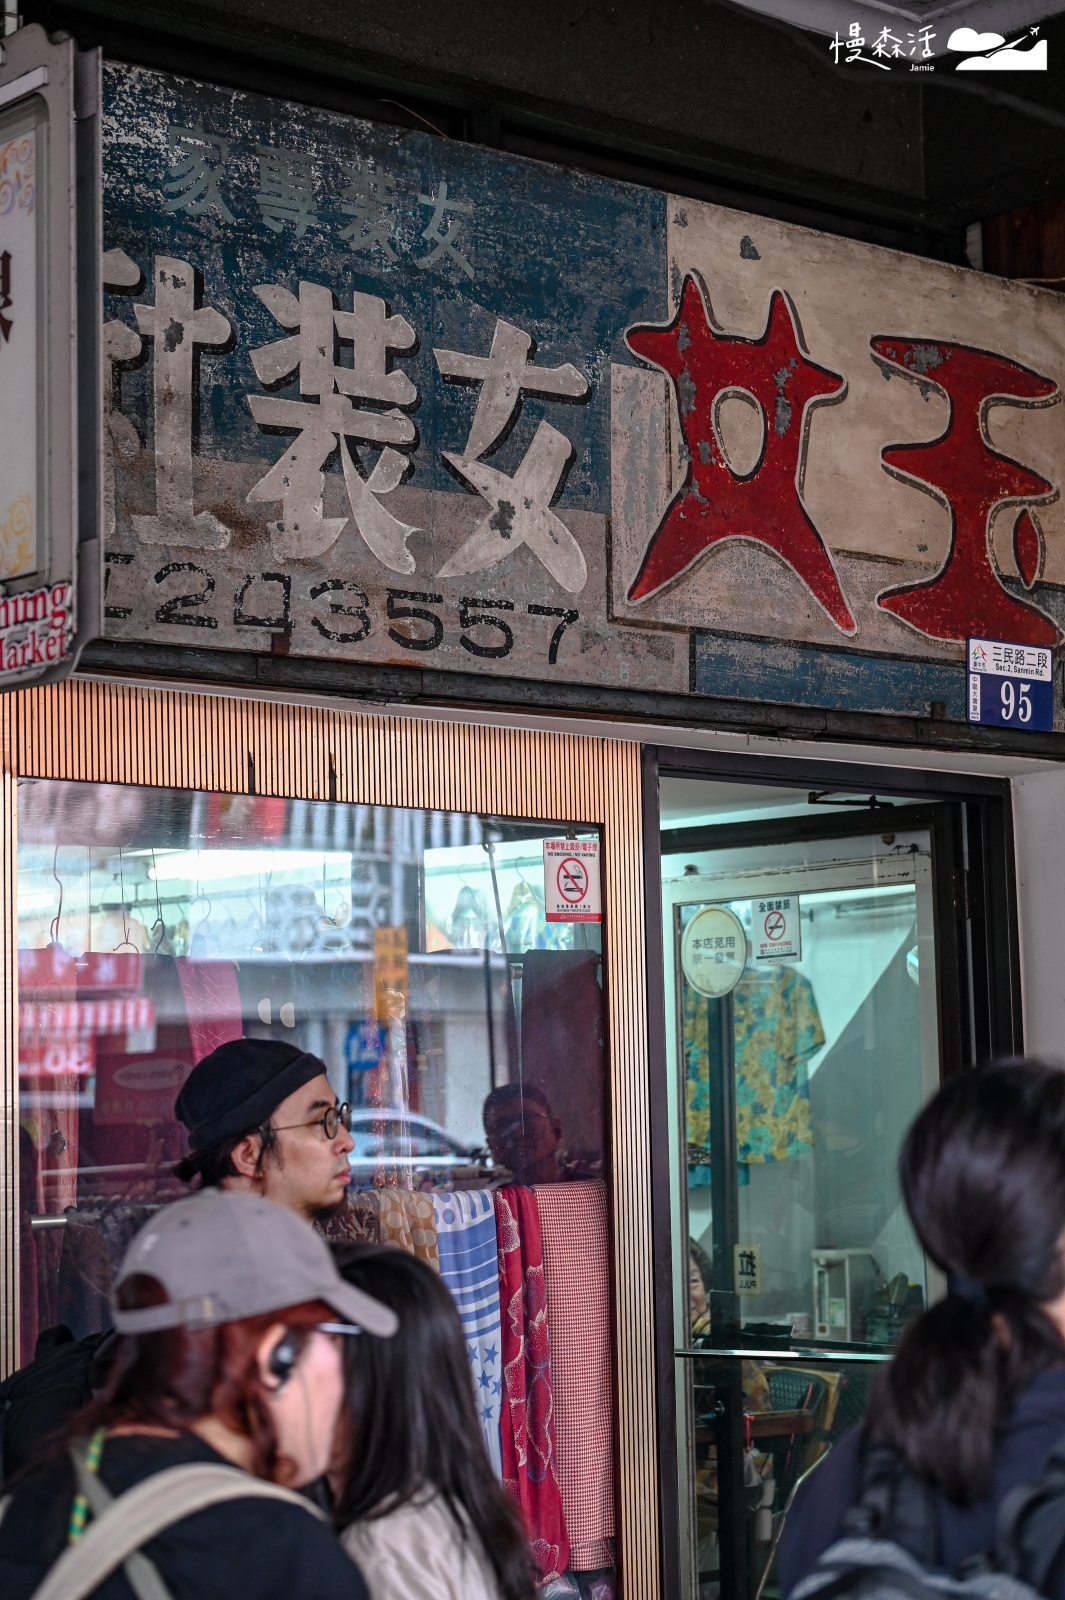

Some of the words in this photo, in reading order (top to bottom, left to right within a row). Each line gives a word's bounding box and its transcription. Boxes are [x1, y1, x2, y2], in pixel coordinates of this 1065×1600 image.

[993, 646, 1048, 669] 三民路二段
[1013, 665, 1034, 675] Sanmin
[1035, 668, 1045, 677] Rd.
[1000, 681, 1032, 722] 95
[758, 899, 791, 913] 全面禁菸
[692, 936, 736, 950] 本店免用
[768, 940, 792, 948] SMOKING
